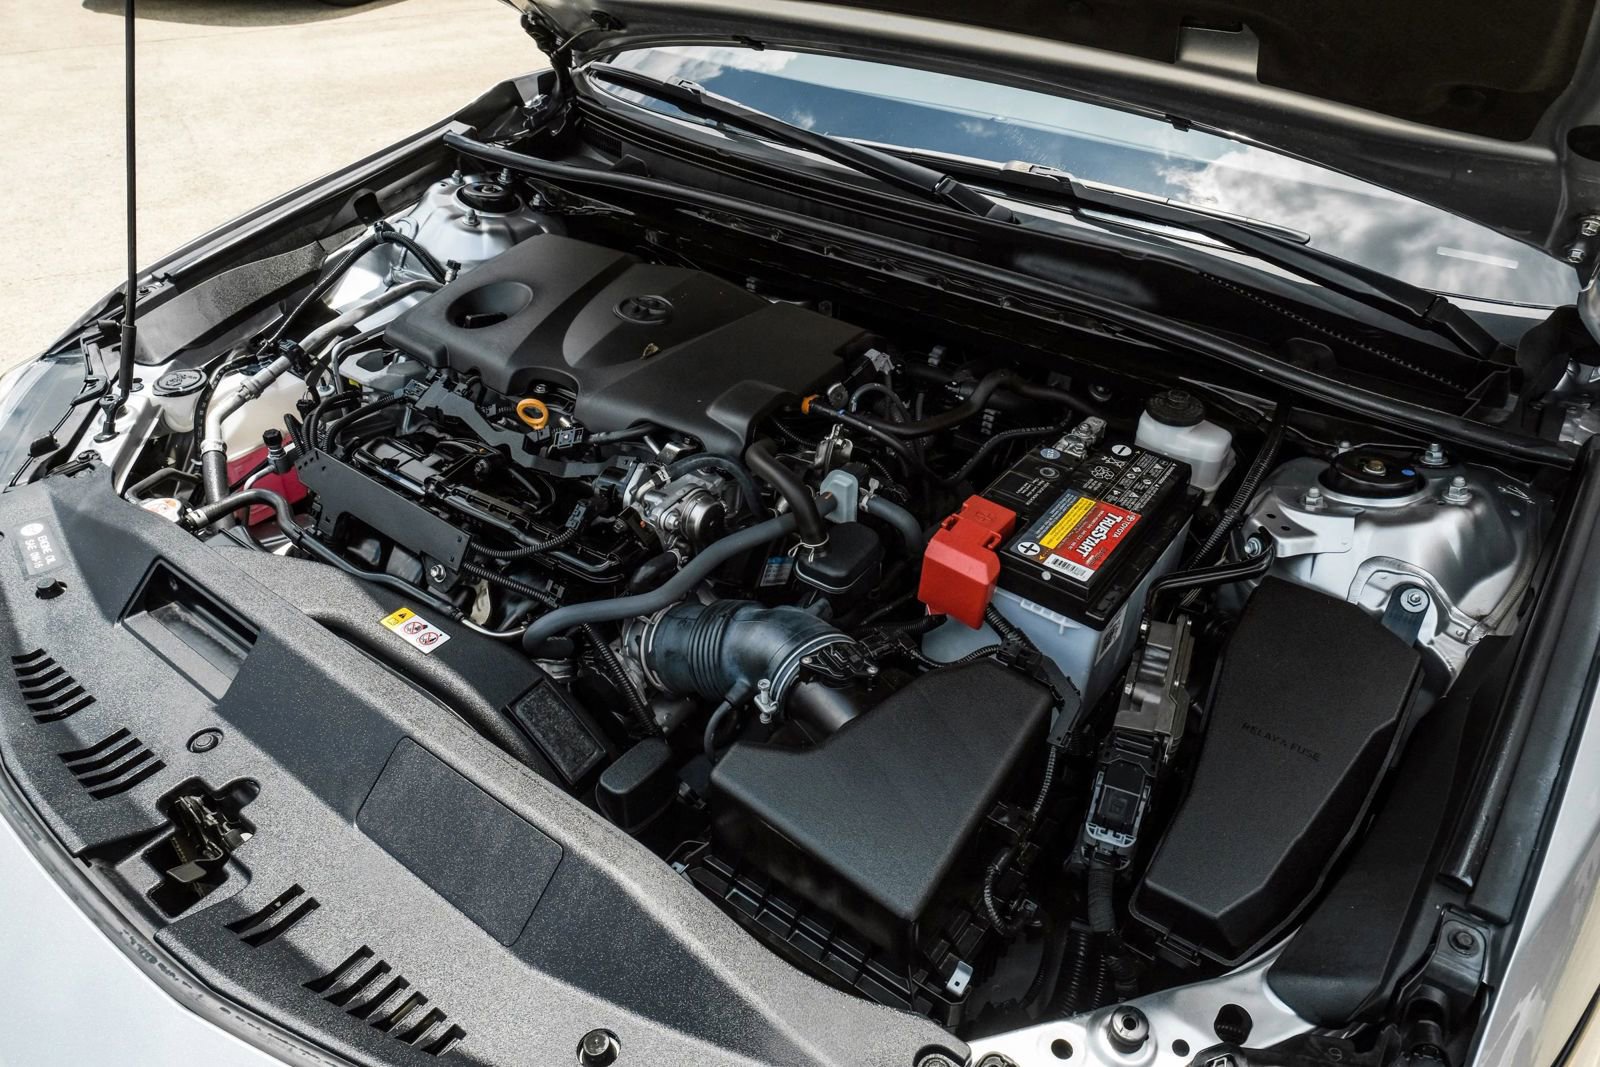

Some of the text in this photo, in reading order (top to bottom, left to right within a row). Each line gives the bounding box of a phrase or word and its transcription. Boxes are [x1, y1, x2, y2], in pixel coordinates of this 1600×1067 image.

[1112, 521, 1131, 538] TOYOTA
[24, 539, 37, 551] SAE
[37, 535, 56, 565] ENGINE OIL
[1241, 721, 1280, 742] RELAY
[1290, 743, 1320, 761] FUSE
